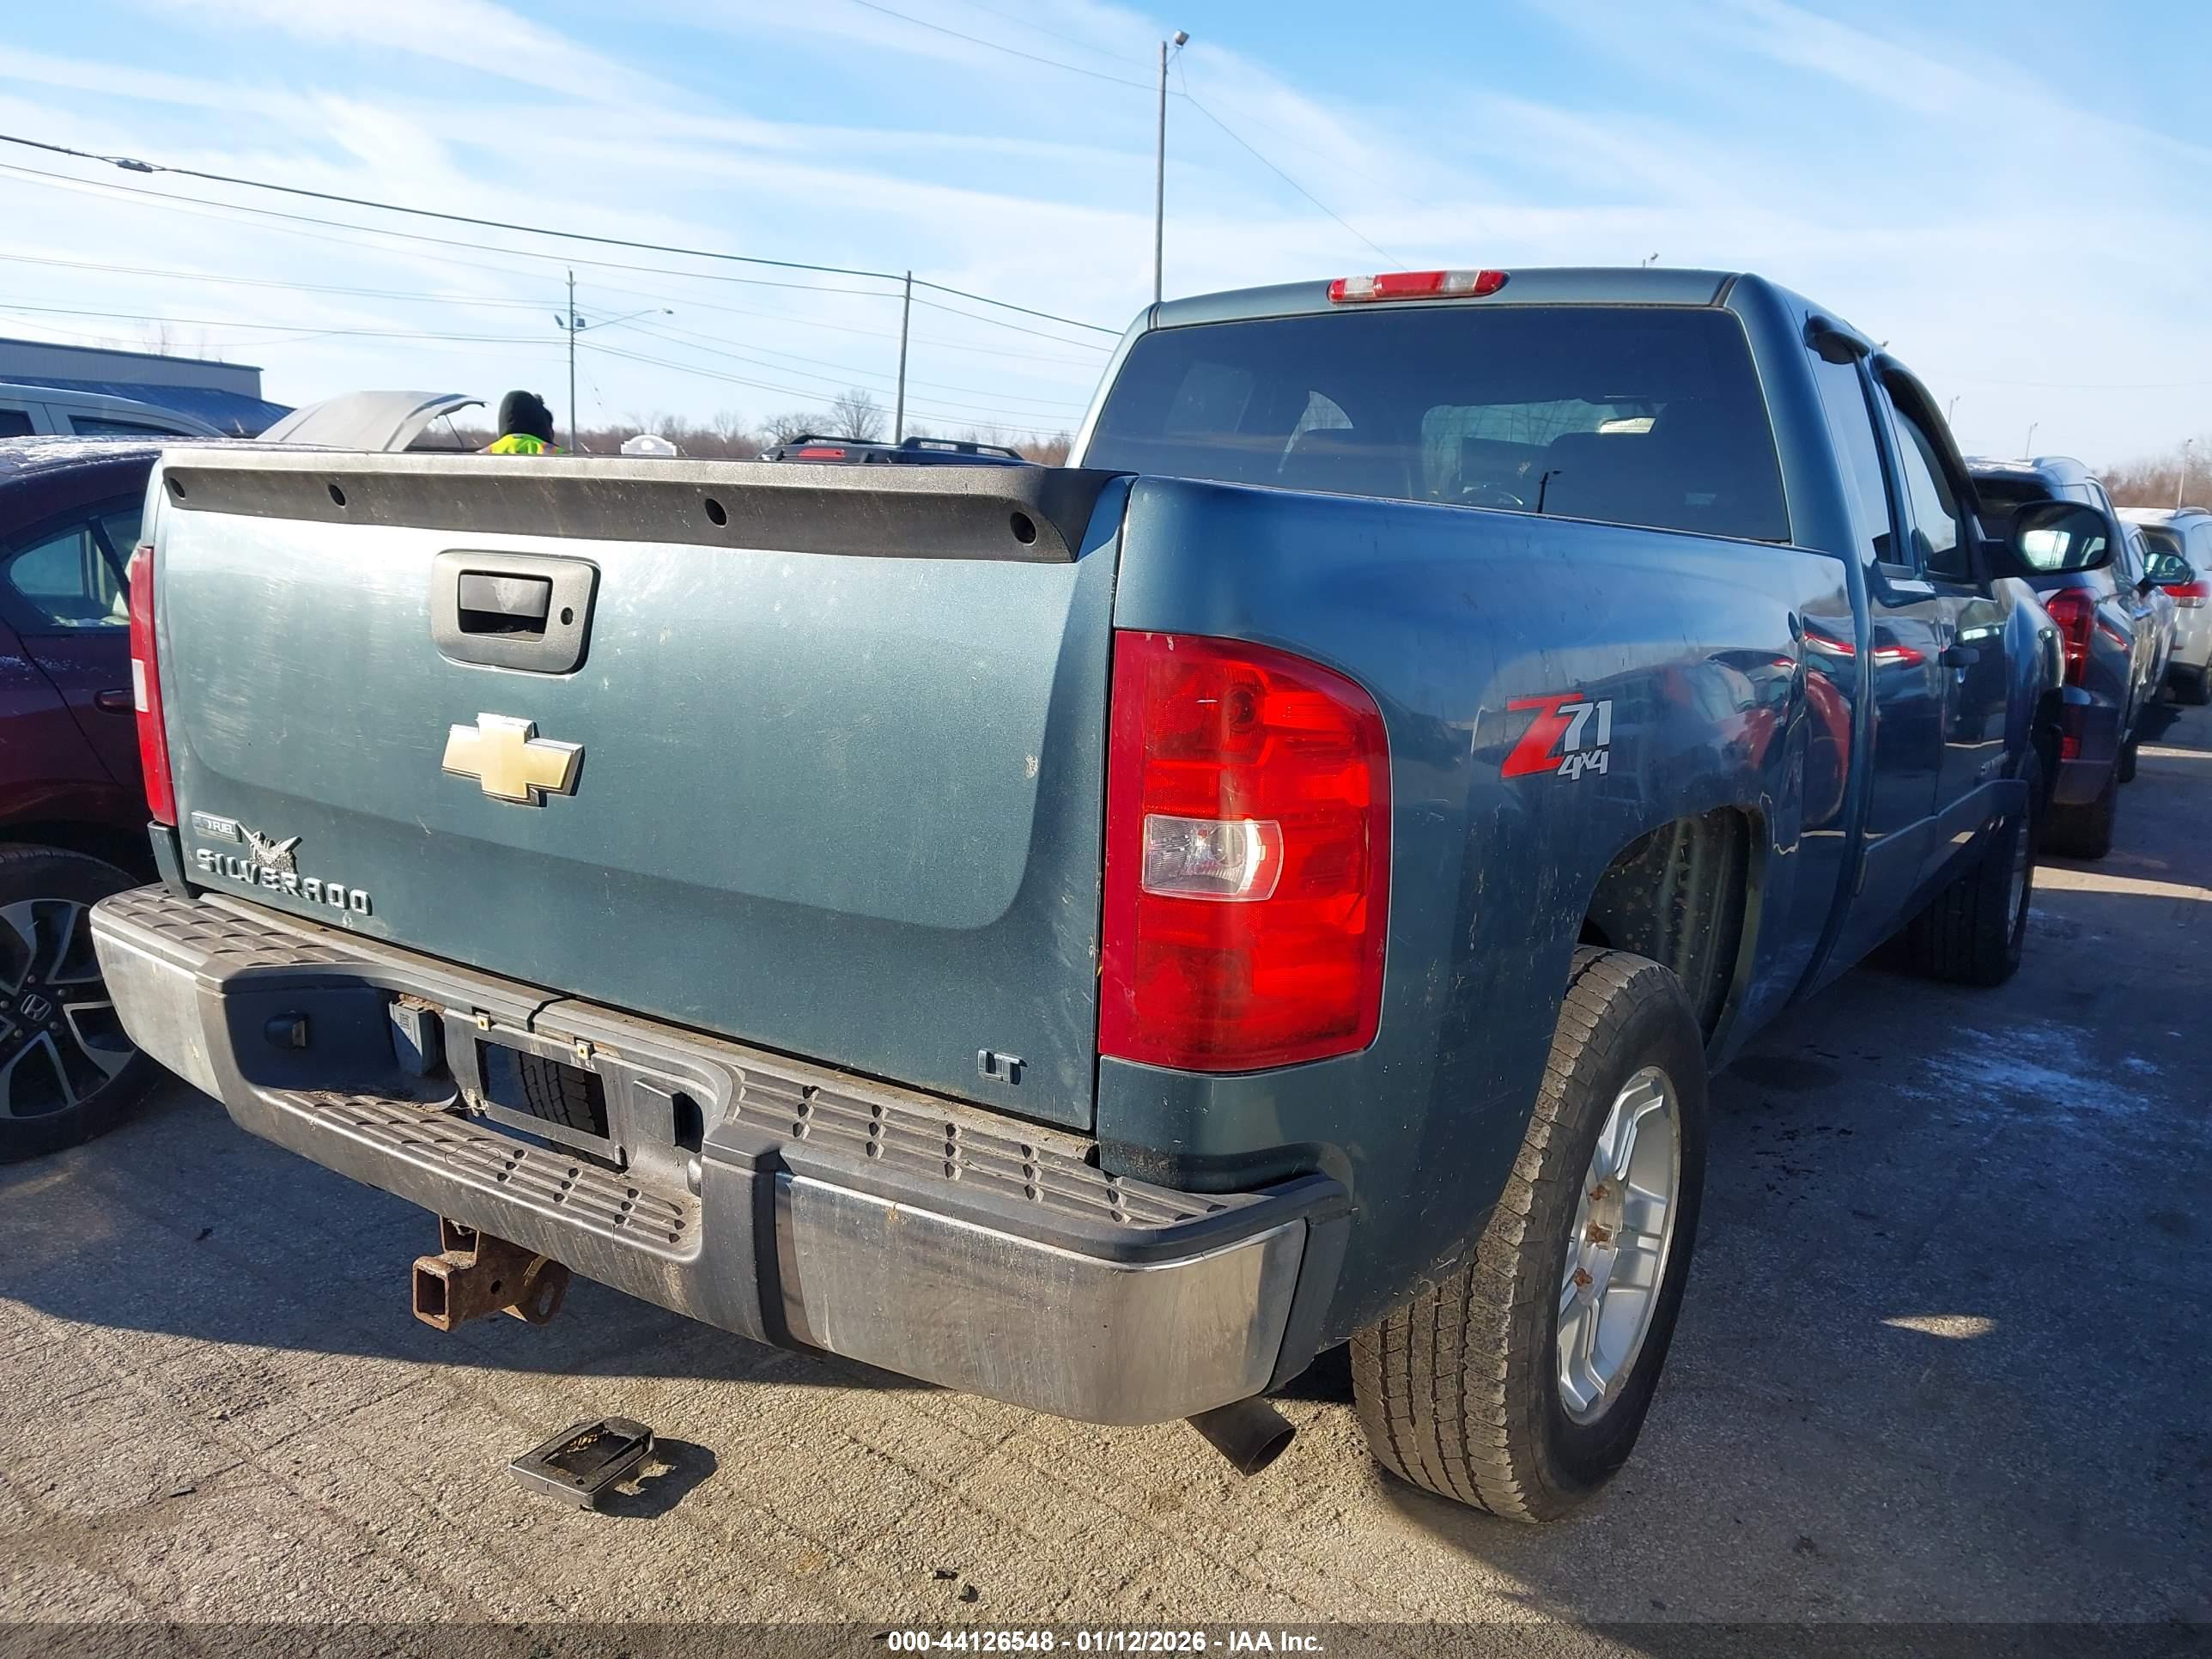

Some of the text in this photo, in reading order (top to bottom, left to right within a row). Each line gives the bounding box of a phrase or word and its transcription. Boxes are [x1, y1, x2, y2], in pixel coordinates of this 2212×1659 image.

[1500, 692, 1613, 779] Z71
[196, 848, 372, 916] SILVERADO
[977, 1048, 1024, 1085] LT
